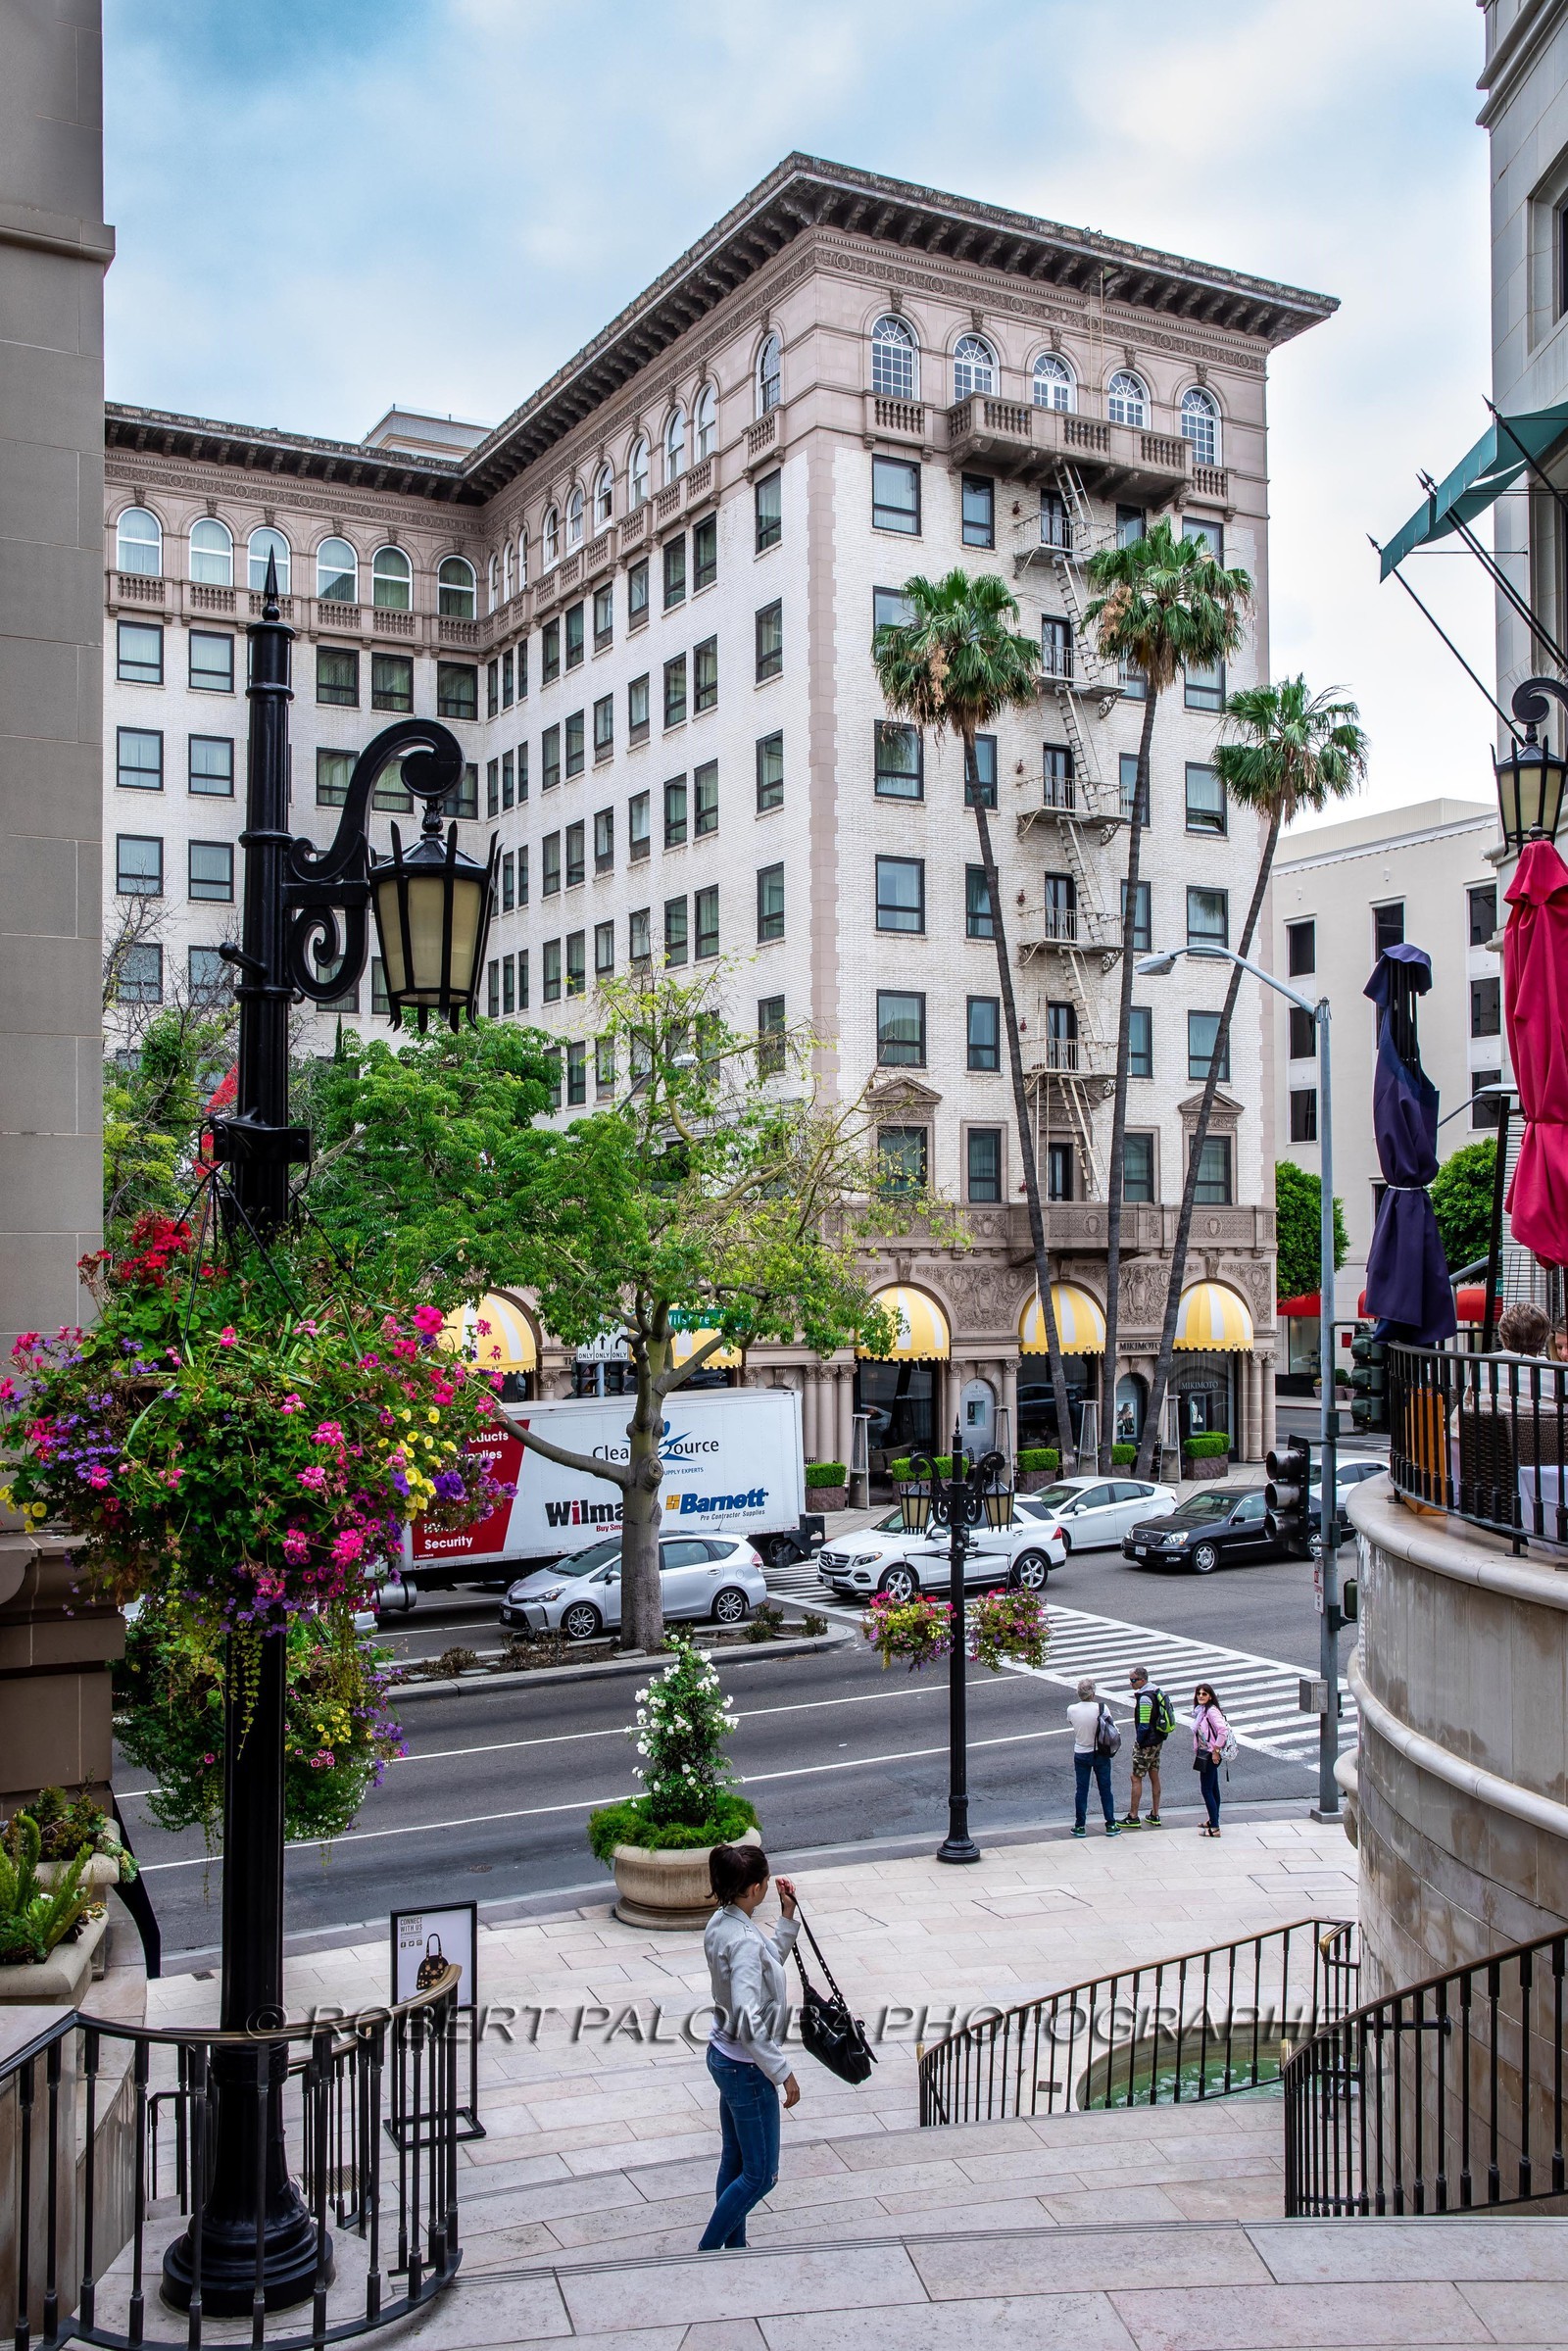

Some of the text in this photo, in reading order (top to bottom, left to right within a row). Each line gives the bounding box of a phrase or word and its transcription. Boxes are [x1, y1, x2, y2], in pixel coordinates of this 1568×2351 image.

[1181, 1381, 1218, 1390] MIKIMOTO
[679, 1487, 764, 1515] Barnett
[545, 1499, 623, 1527] Wilma
[424, 1536, 473, 1549] Security
[401, 1917, 422, 1926] CONNECT
